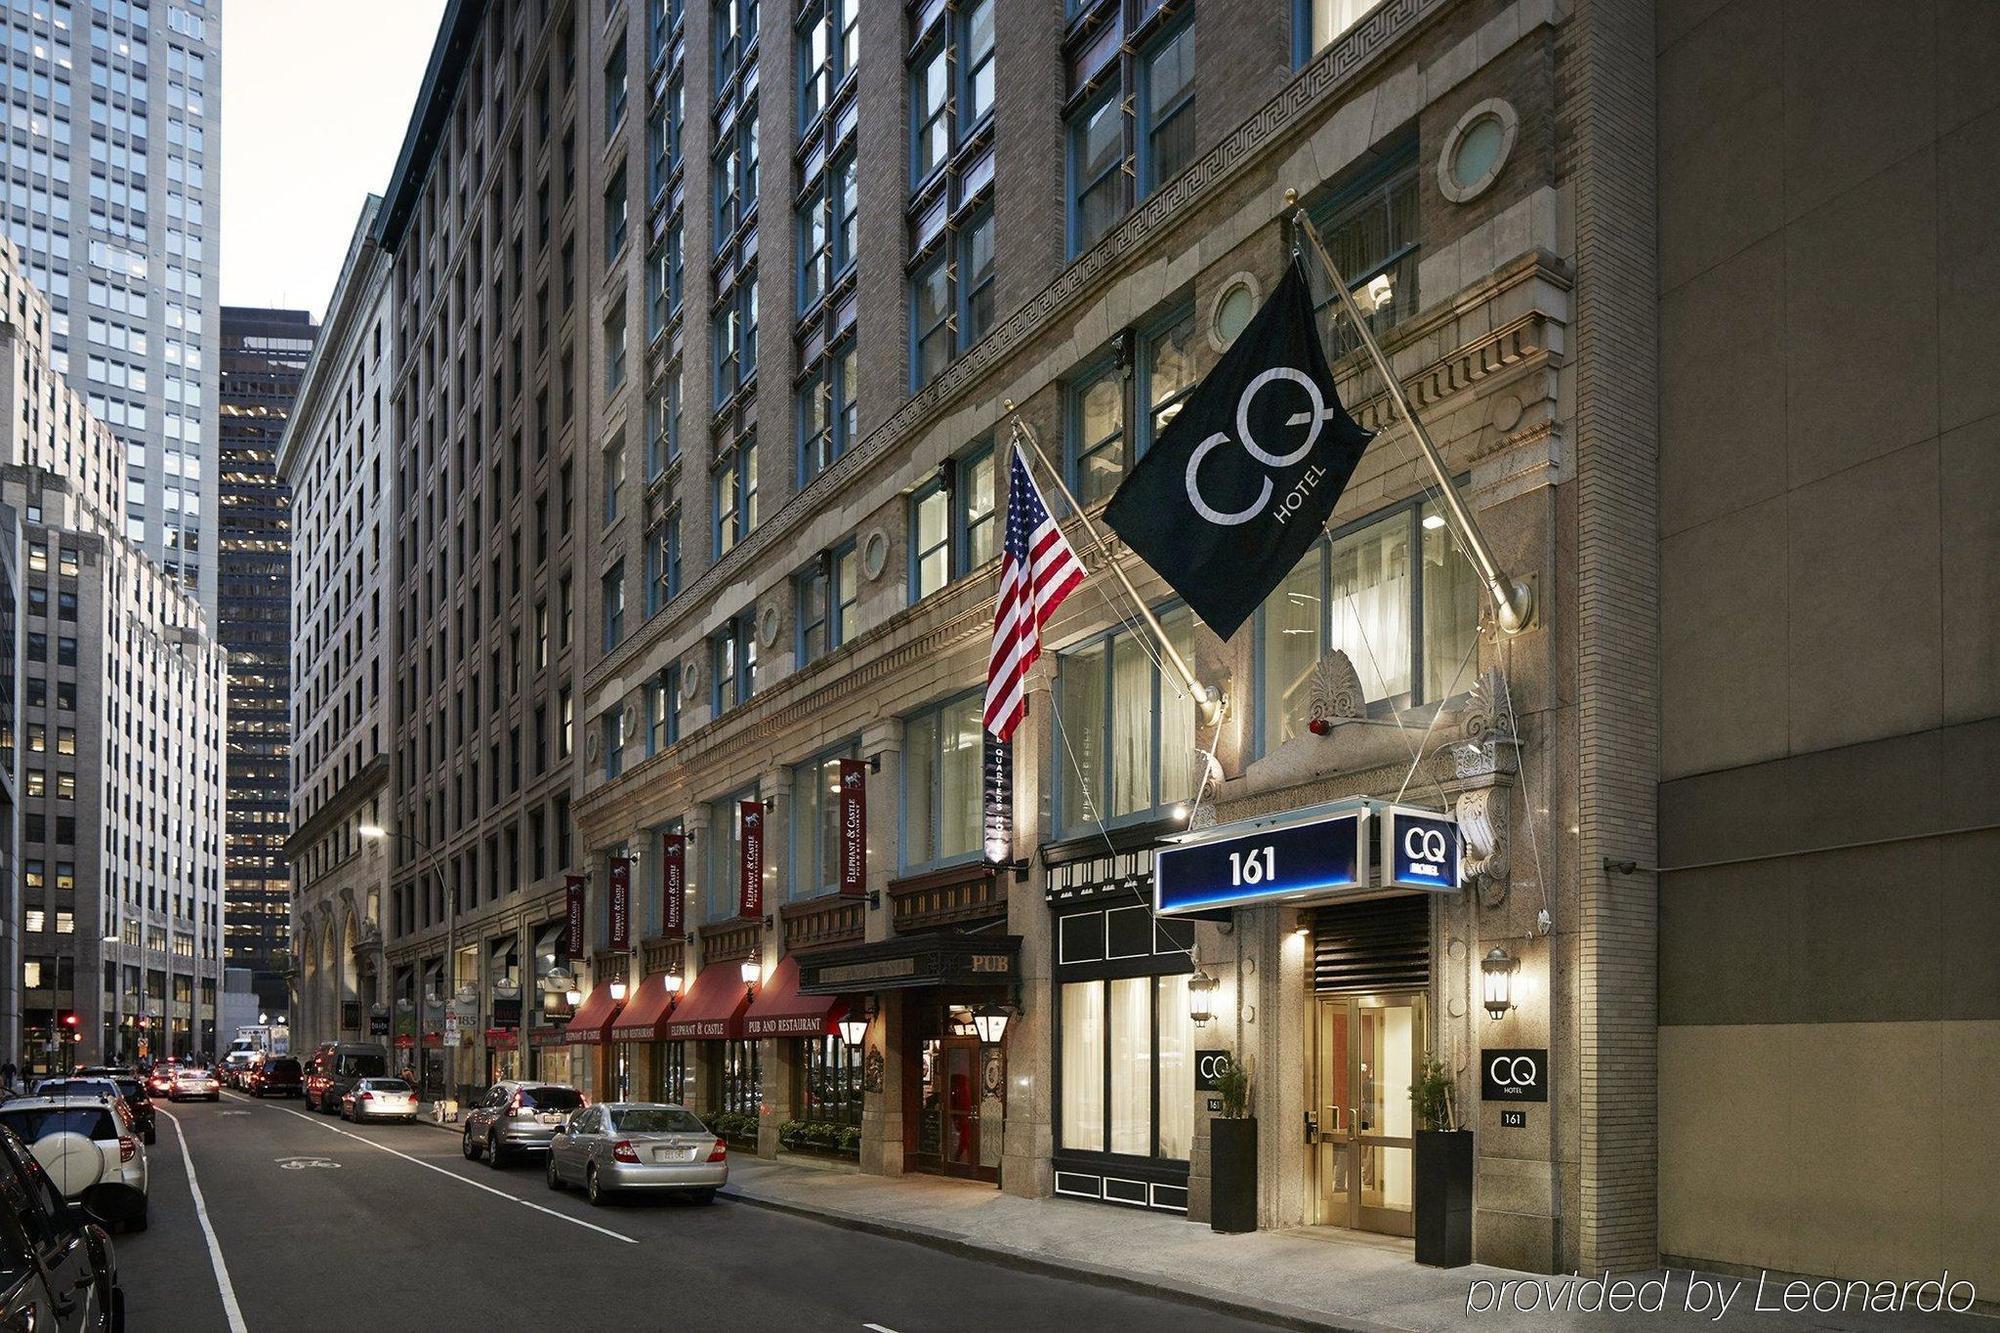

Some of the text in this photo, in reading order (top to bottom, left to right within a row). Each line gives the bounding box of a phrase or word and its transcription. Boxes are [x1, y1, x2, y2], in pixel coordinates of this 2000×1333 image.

[1185, 367, 1334, 526] CQ
[1273, 464, 1327, 525] HOTEL
[995, 748, 1003, 811] QUARTERS
[847, 799, 856, 883] ELEPHANT & CASTLE
[1404, 826, 1446, 863] CQ
[745, 835, 755, 908] ELEPHANT & CASTLE
[1229, 846, 1275, 886] 161
[972, 955, 1009, 972] PUB
[671, 1024, 695, 1036] ELEPHANT
[704, 1023, 724, 1035] CASTLE
[749, 1018, 822, 1033] PUB AND RESTAURANT
[1490, 1056, 1537, 1086] CQ
[1210, 1101, 1220, 1109] 161
[1505, 1114, 1520, 1124] 161
